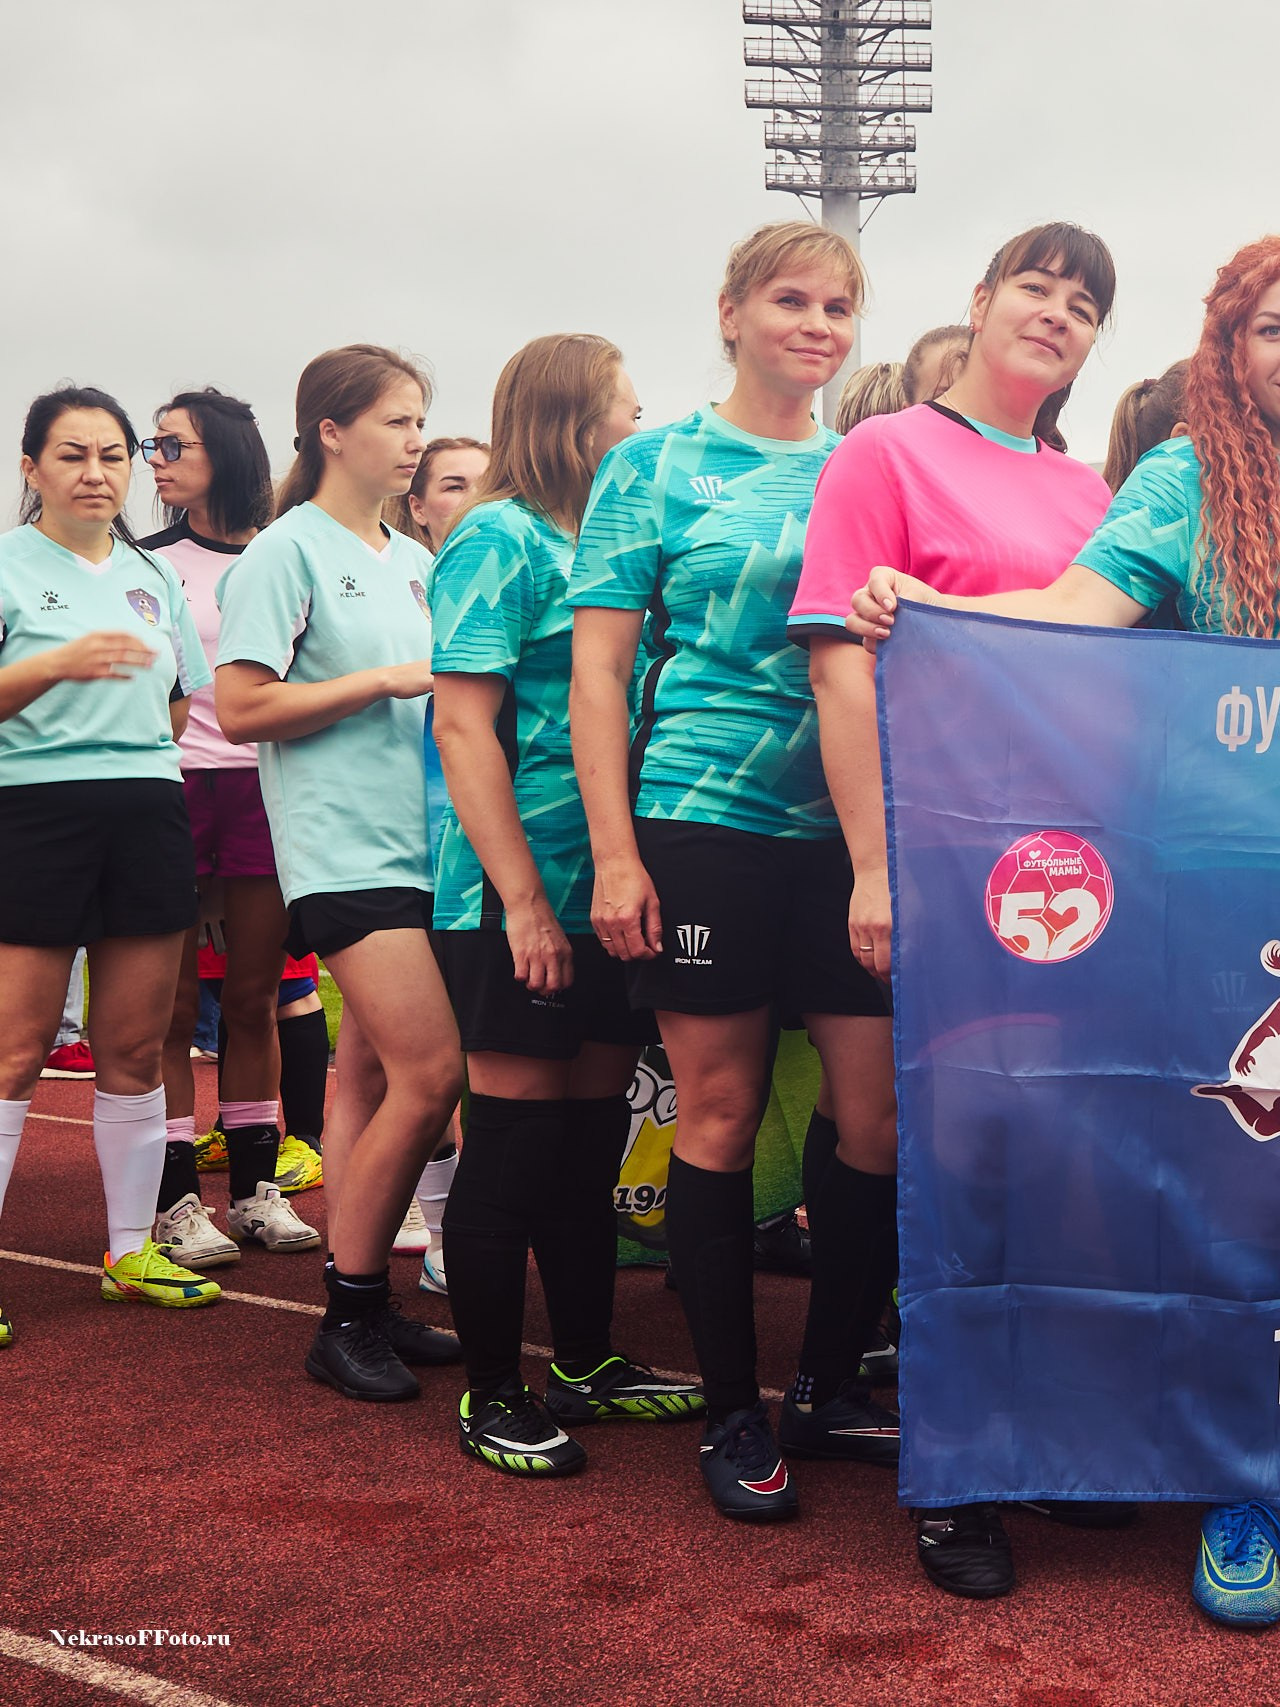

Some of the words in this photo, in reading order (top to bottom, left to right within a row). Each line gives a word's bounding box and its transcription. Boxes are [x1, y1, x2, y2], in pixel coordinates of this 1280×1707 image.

[1023, 857, 1082, 867] ФУТБОЛЬНЫЕ
[1049, 866, 1082, 876] МАМЫ
[999, 888, 1100, 960] 52
